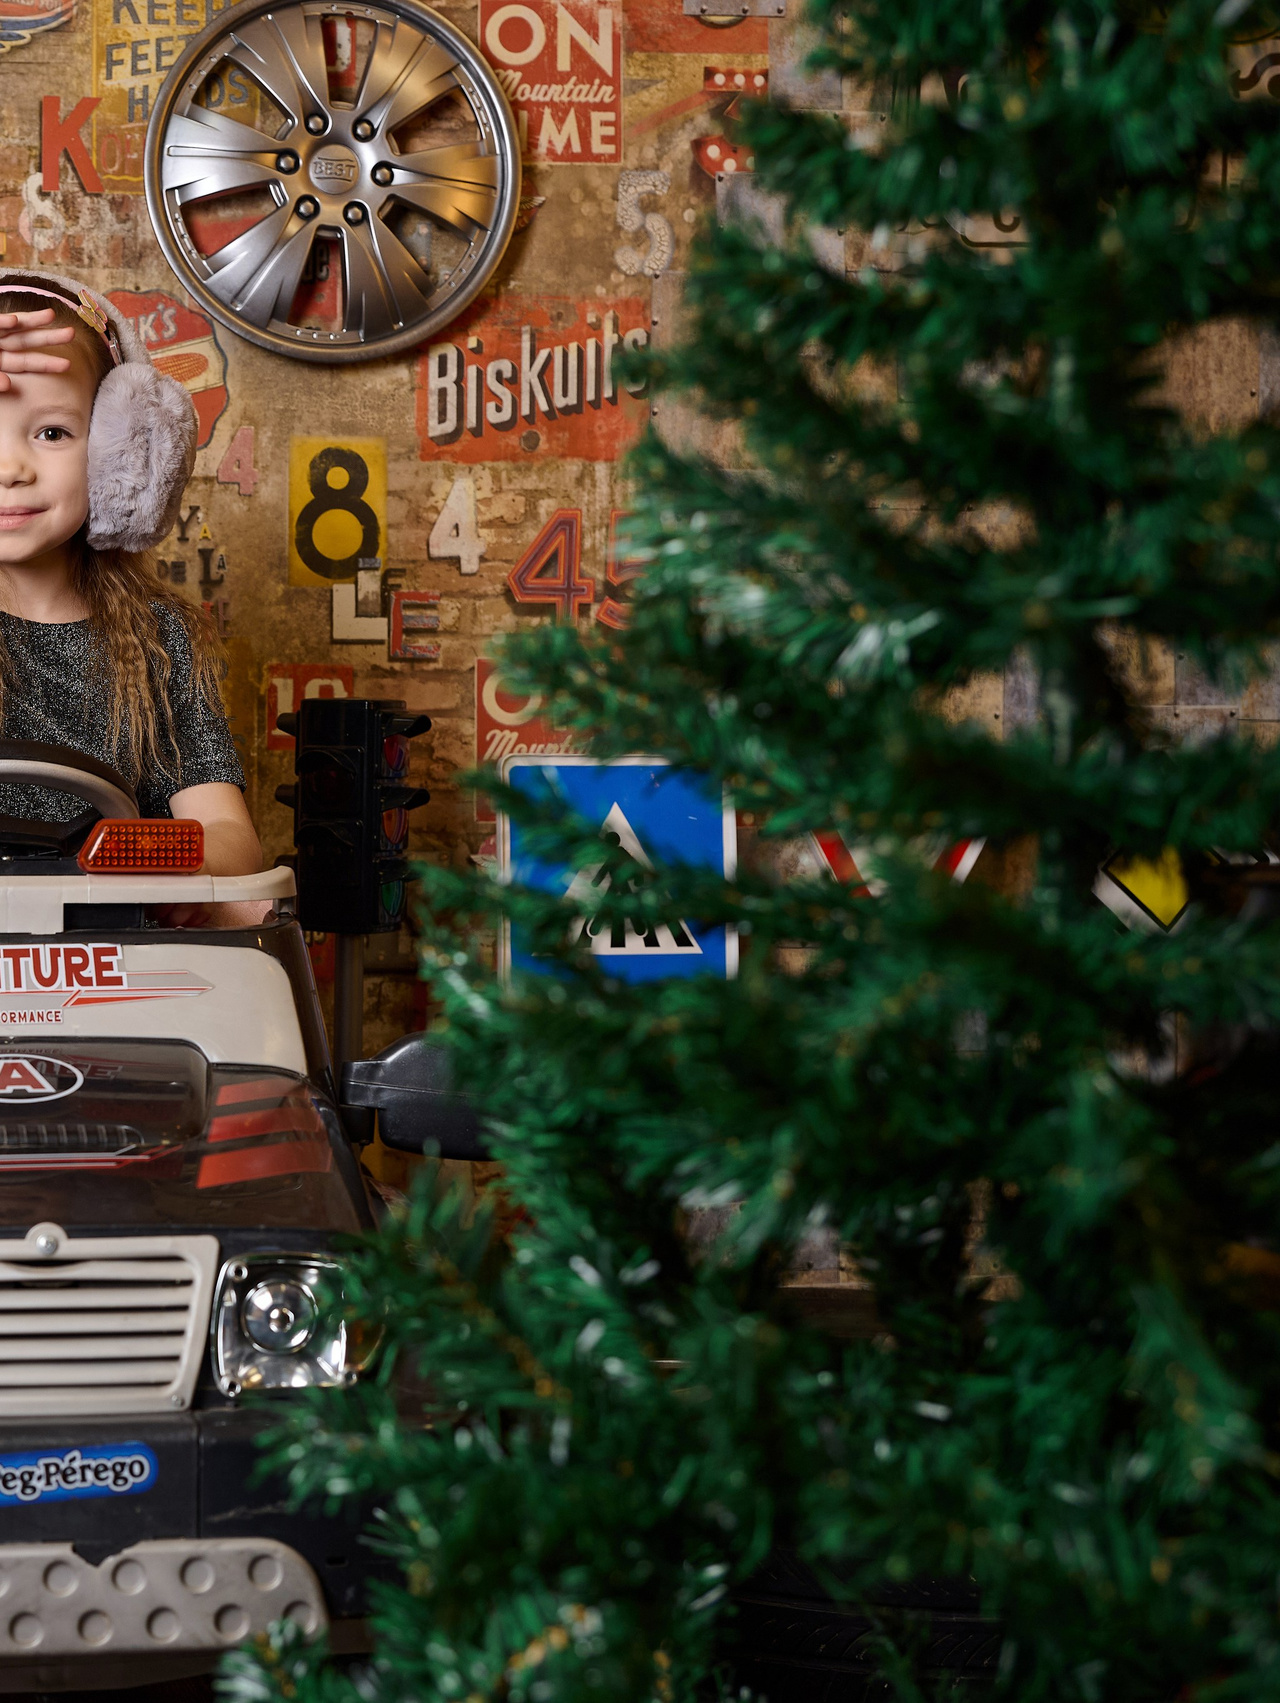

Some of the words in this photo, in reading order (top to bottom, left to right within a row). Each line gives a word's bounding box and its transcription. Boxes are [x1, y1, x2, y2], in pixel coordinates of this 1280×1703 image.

[106, 33, 198, 80] FEE
[485, 3, 613, 78] ON
[495, 69, 616, 103] Mountain
[42, 95, 105, 193] K
[519, 106, 616, 155] IME
[313, 161, 356, 177] BEST
[616, 170, 675, 276] 5
[127, 303, 177, 342] K'S
[217, 427, 258, 495] 4
[295, 447, 379, 578] 8
[429, 480, 486, 574] 4
[483, 729, 600, 760] Mount
